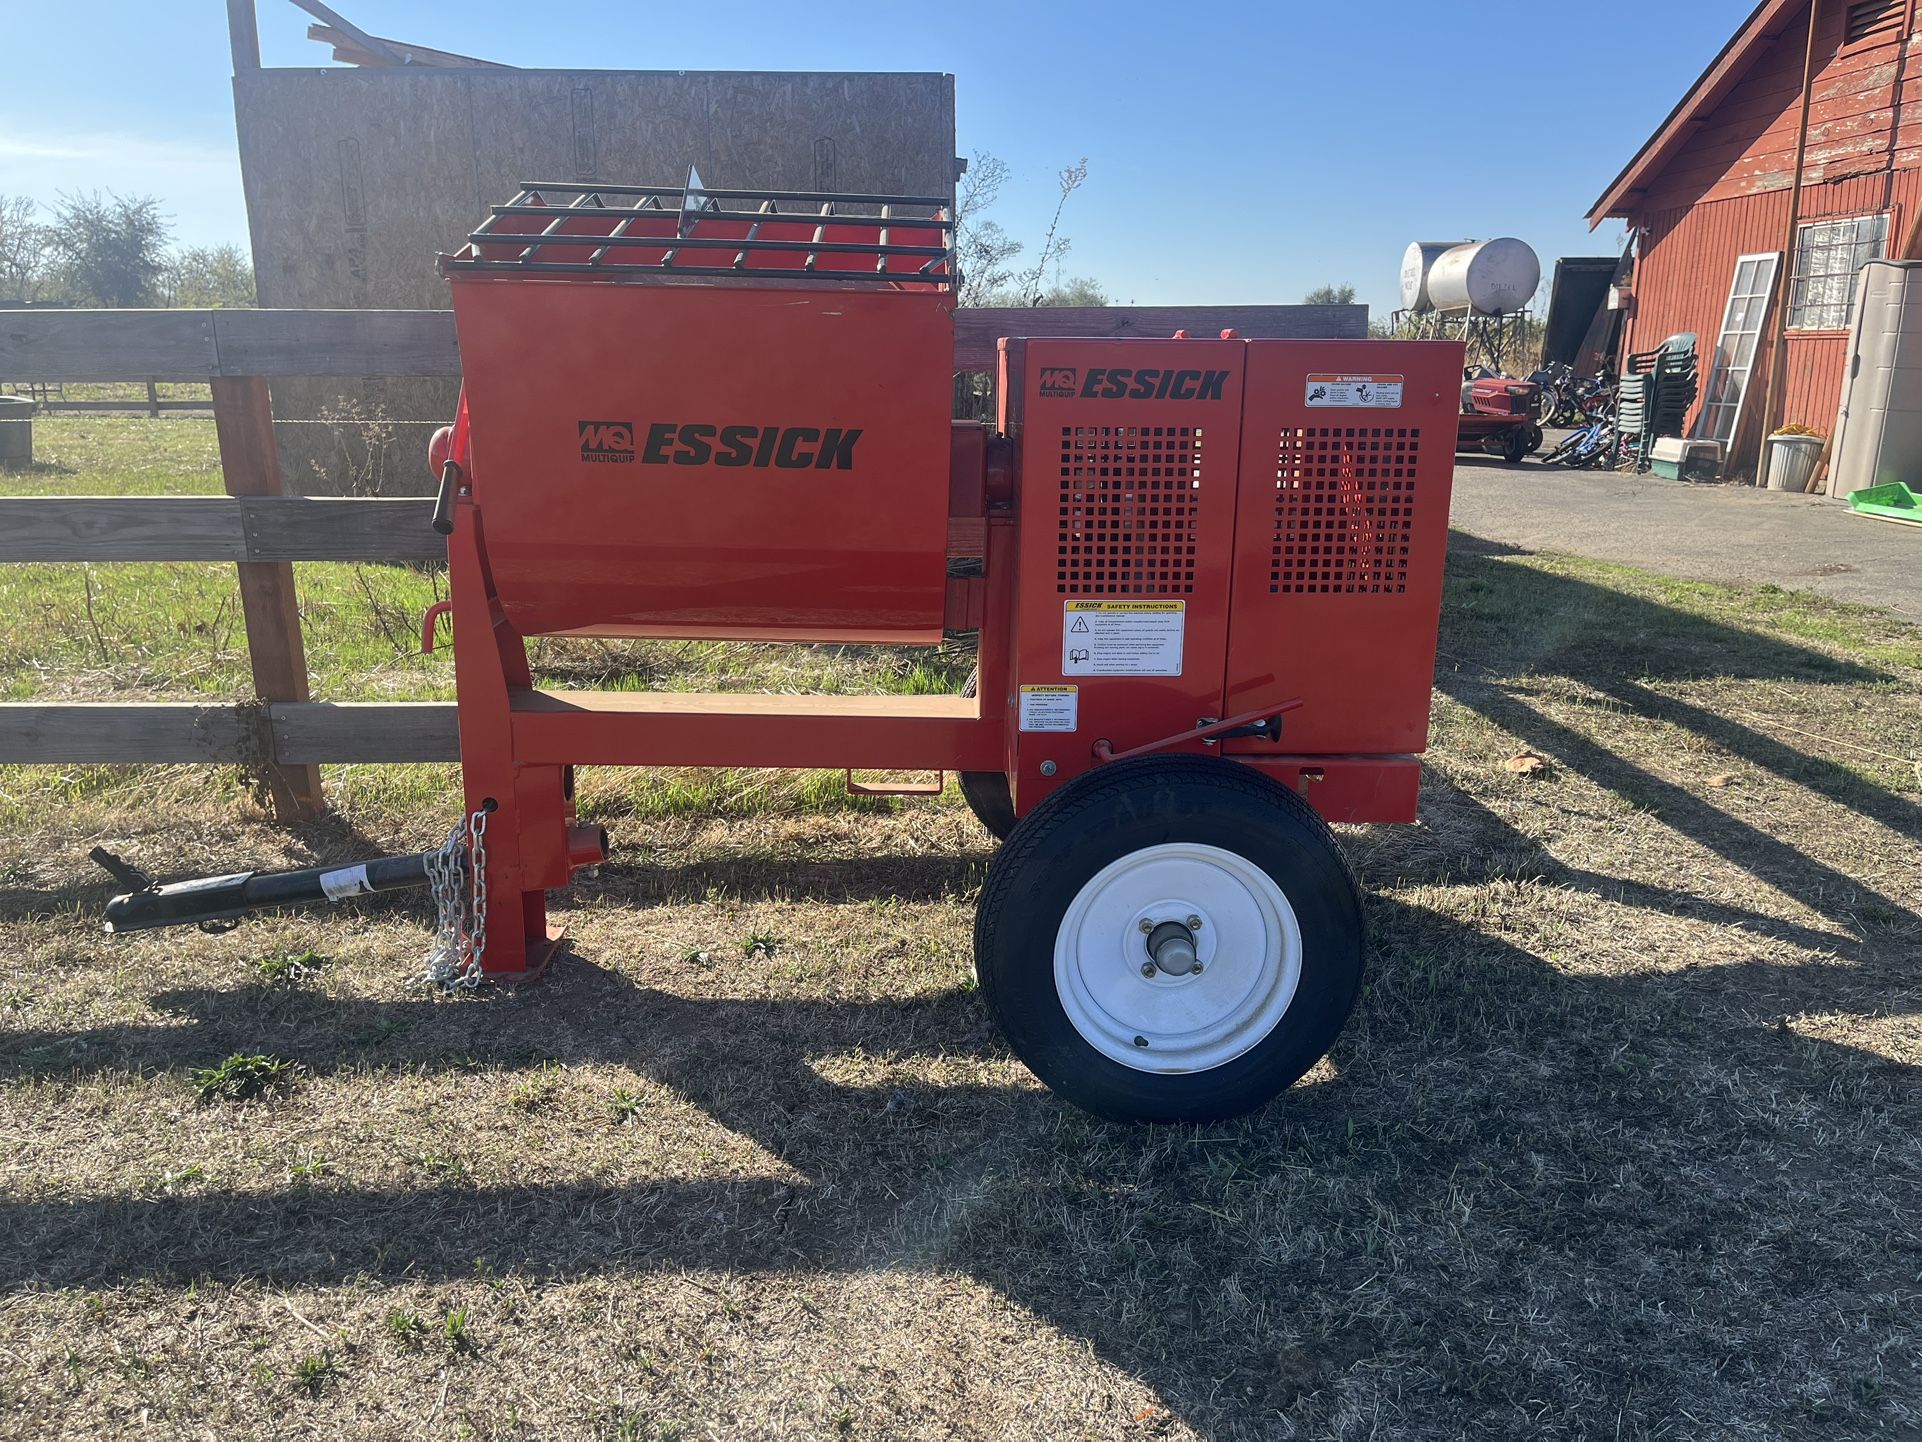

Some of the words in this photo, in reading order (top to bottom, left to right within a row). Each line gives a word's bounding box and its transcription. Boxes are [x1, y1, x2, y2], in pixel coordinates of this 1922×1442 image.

[1040, 368, 1076, 390] MQ
[1080, 368, 1230, 400] ESSICK
[1040, 390, 1075, 398] MULTIQUIP
[579, 421, 634, 454] MQ
[641, 423, 863, 470] ESSICK
[581, 453, 635, 464] MULTIQUIP
